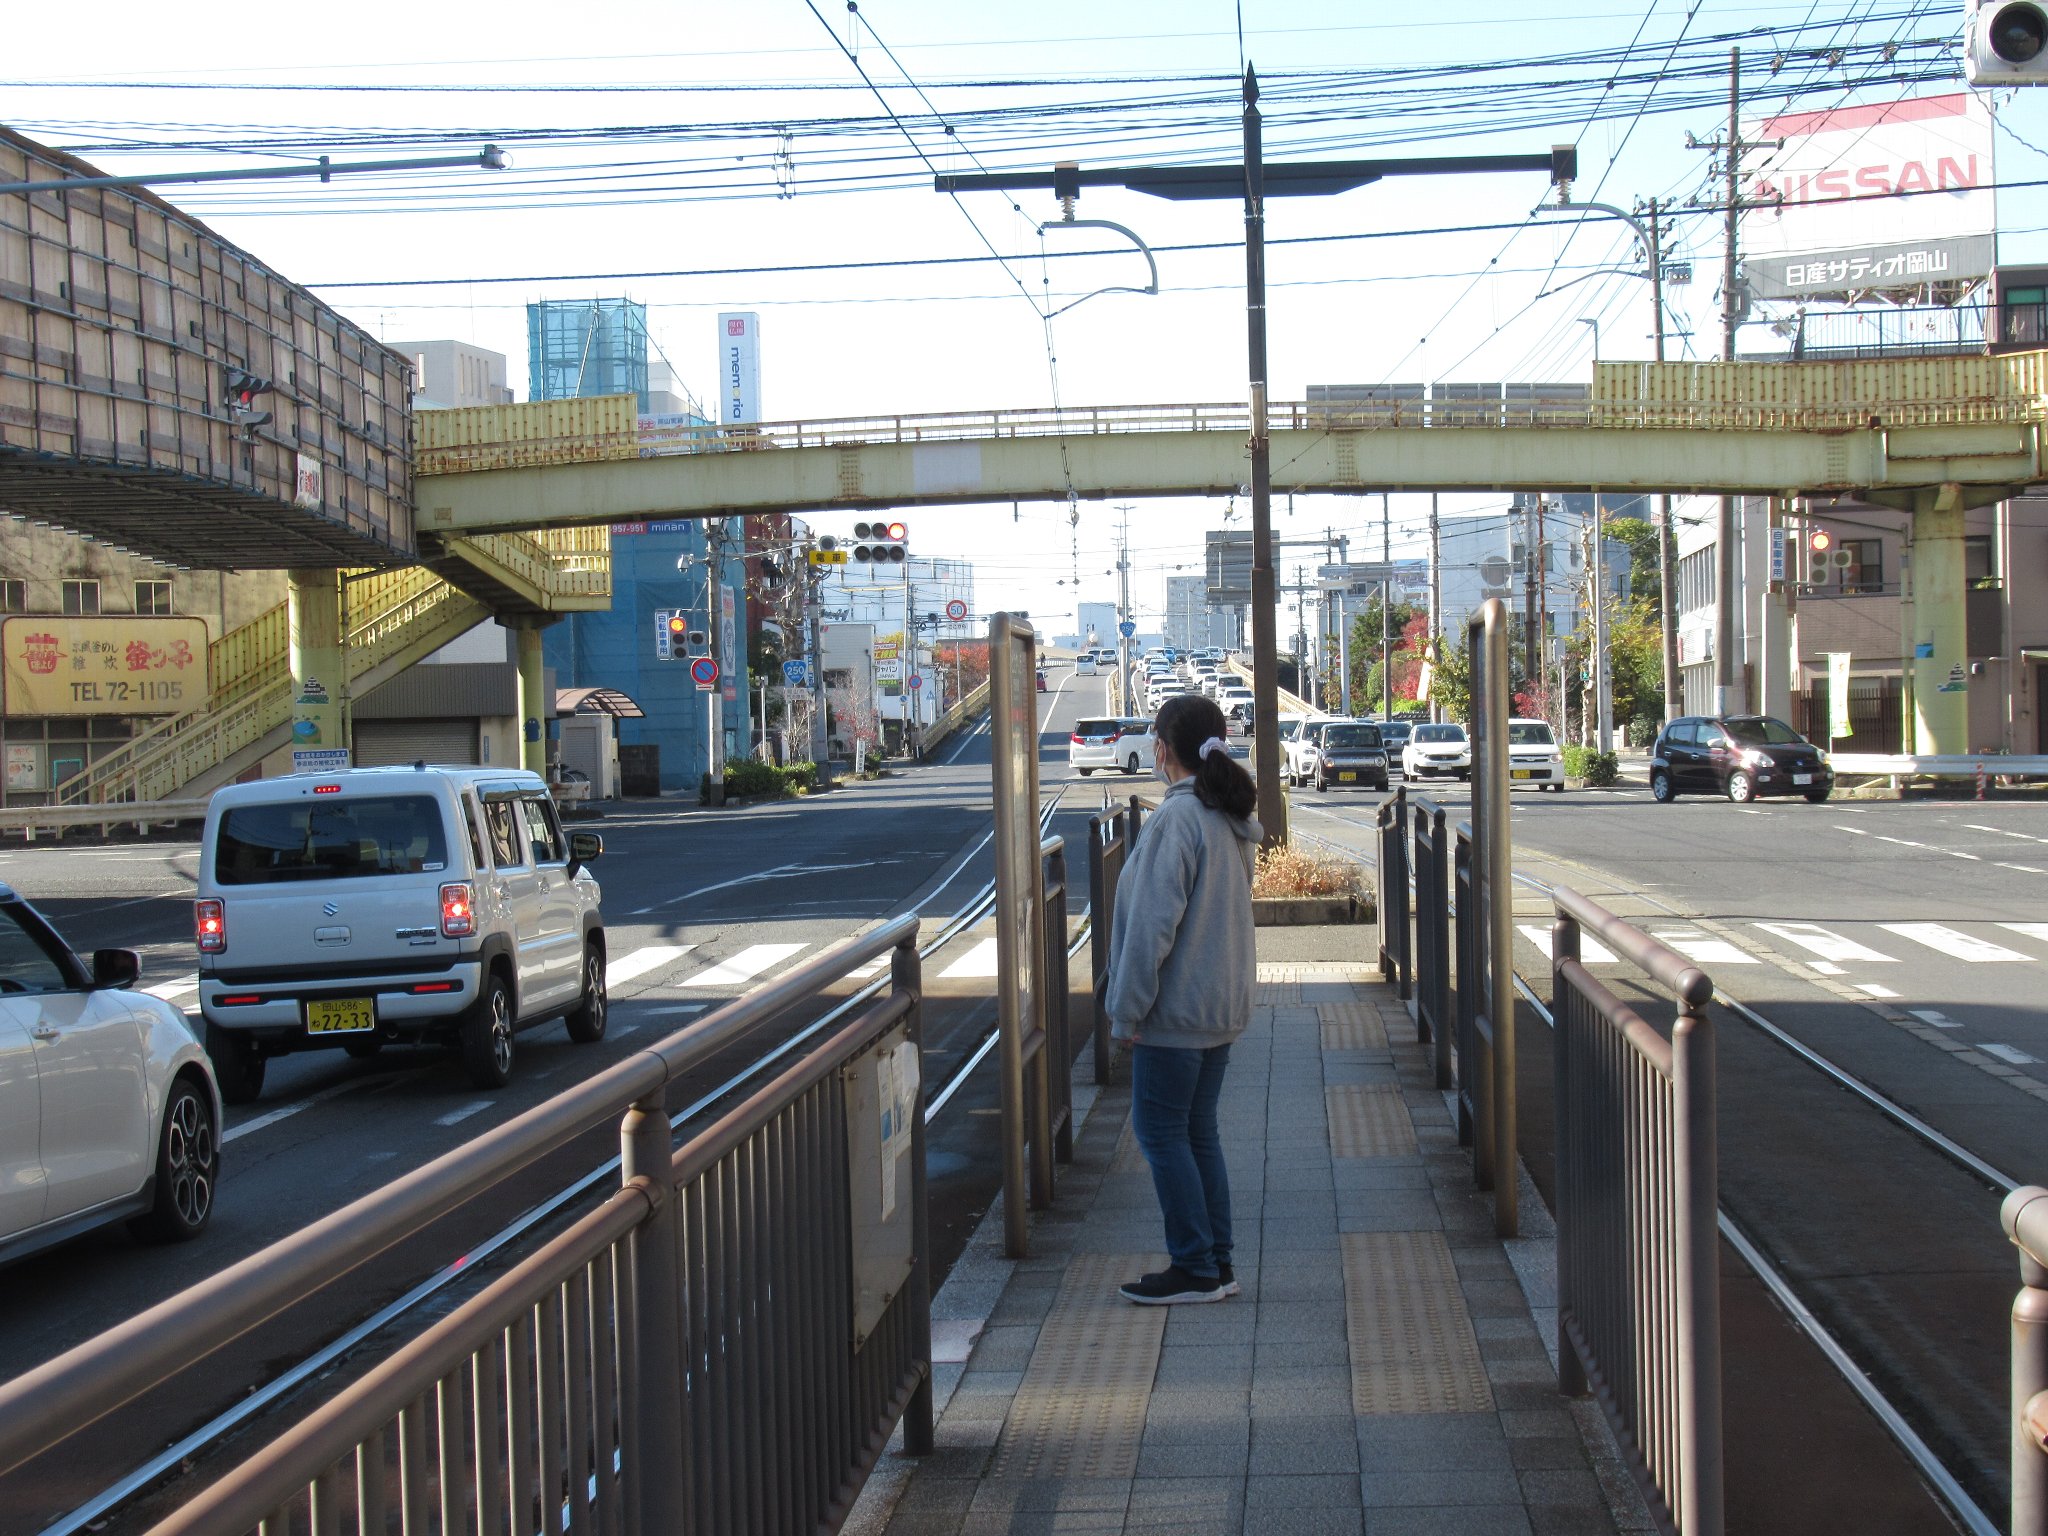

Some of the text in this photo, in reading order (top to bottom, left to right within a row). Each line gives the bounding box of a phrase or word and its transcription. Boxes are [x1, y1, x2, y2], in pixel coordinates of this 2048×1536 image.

[1755, 153, 1978, 214] NISSAN
[1785, 249, 1949, 288] 日産サティオ岡山
[730, 346, 744, 419] memoria
[815, 552, 841, 563] 電車
[1772, 531, 1783, 577] 自転車専用
[950, 605, 963, 615] 50
[658, 615, 668, 655] 自転車専用
[786, 665, 805, 676] 250
[70, 681, 183, 702] TEL 72-1105
[322, 1011, 371, 1031] 22-33
